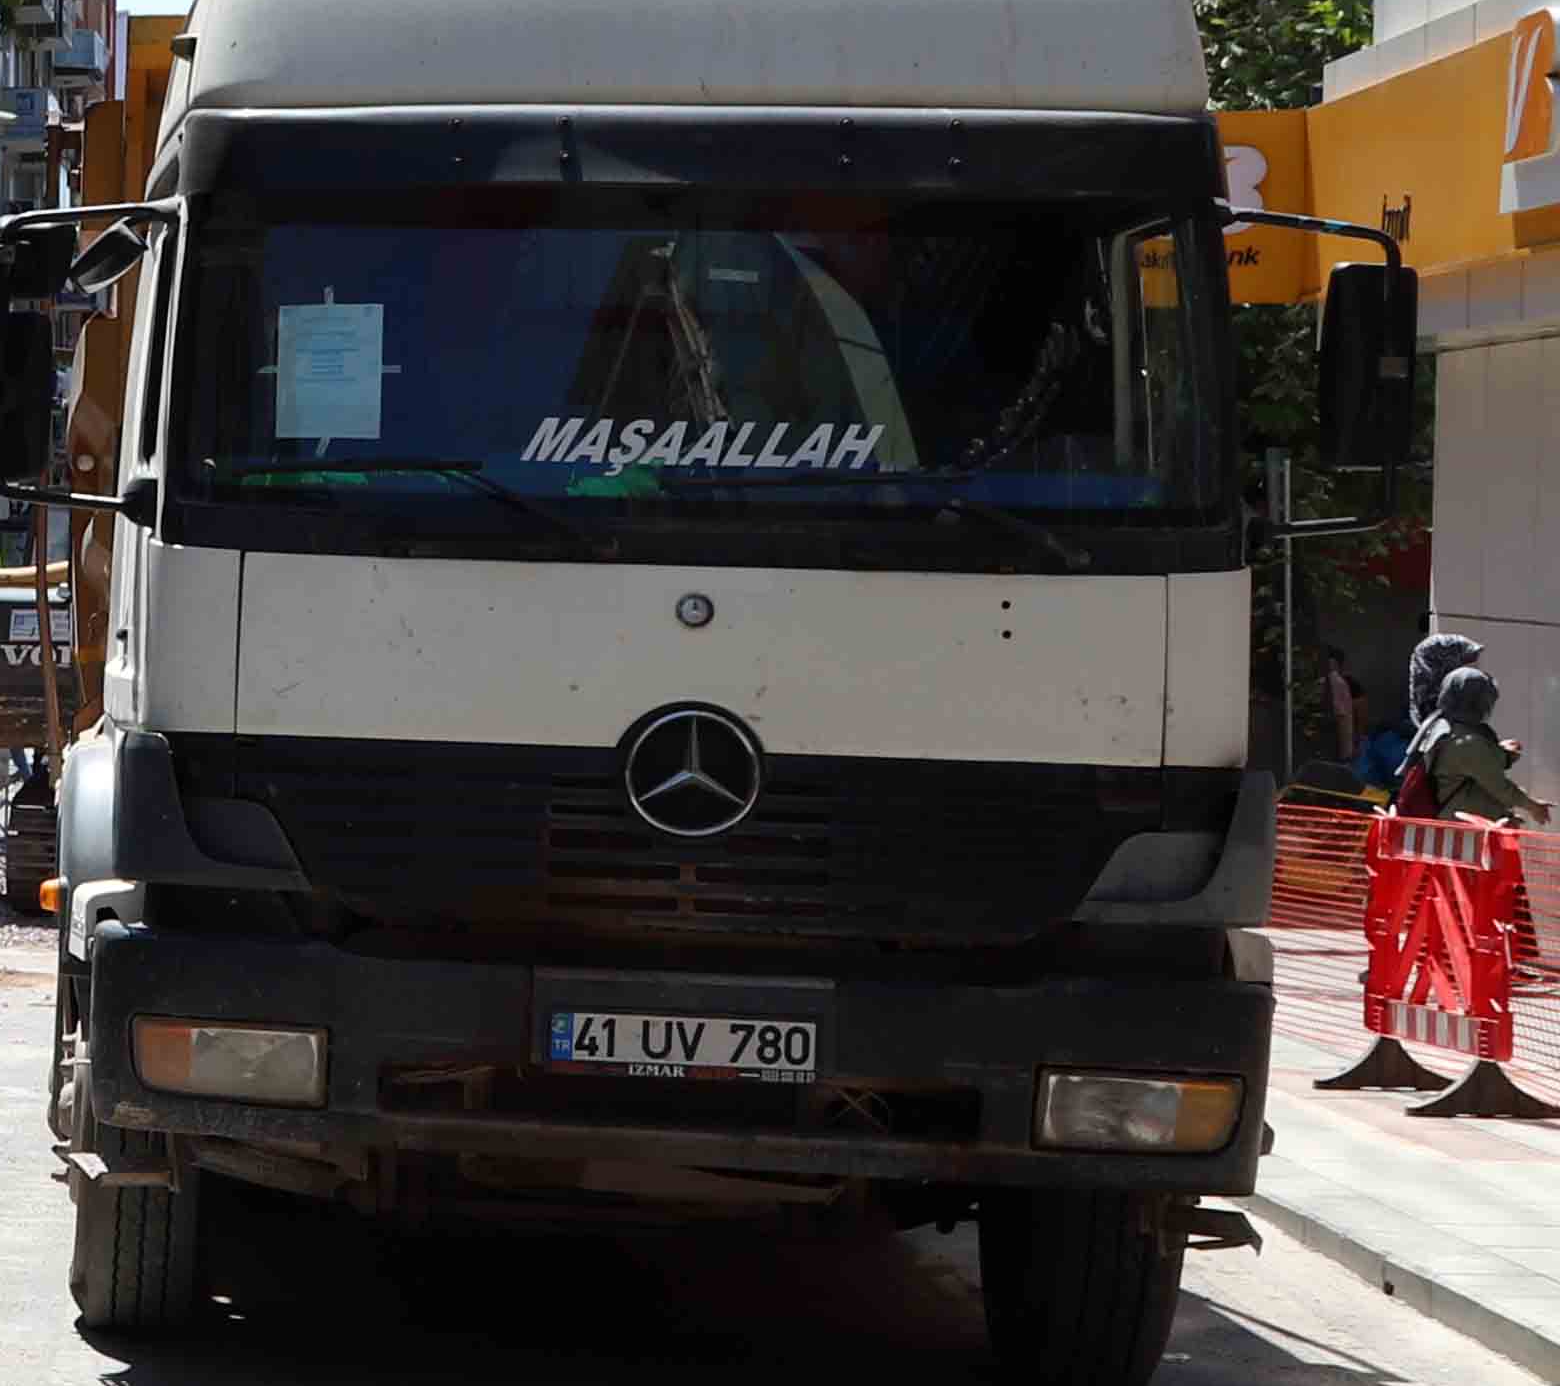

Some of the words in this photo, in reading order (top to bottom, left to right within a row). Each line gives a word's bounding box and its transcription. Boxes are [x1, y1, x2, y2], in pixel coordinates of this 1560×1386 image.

[520, 415, 885, 477] MAŞAALLAH
[554, 1039, 570, 1052] TR
[574, 1016, 616, 1058] 41
[640, 1019, 706, 1062] UV
[728, 1022, 811, 1066] 780
